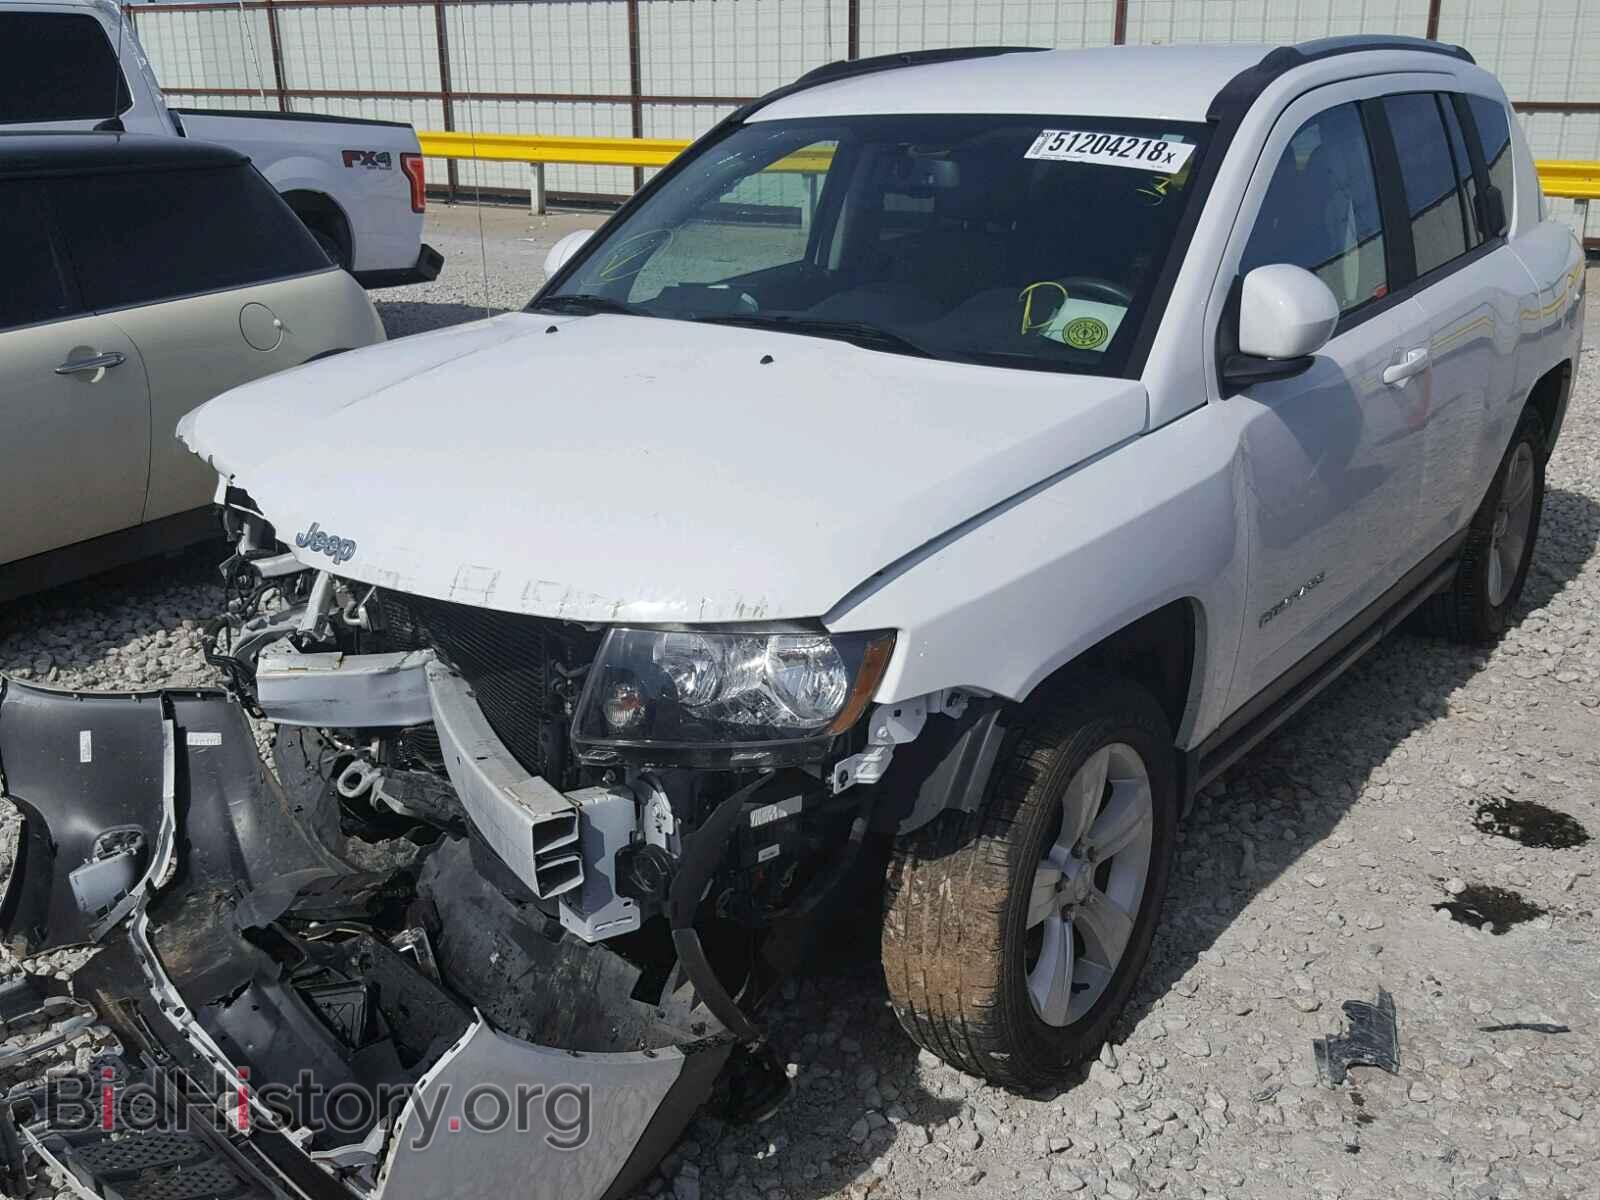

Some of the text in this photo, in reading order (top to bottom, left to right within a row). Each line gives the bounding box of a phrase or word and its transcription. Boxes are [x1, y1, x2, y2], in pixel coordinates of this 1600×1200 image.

[342, 150, 391, 168] FX4
[1048, 132, 1168, 162] 51204218
[296, 522, 356, 565] Jeep
